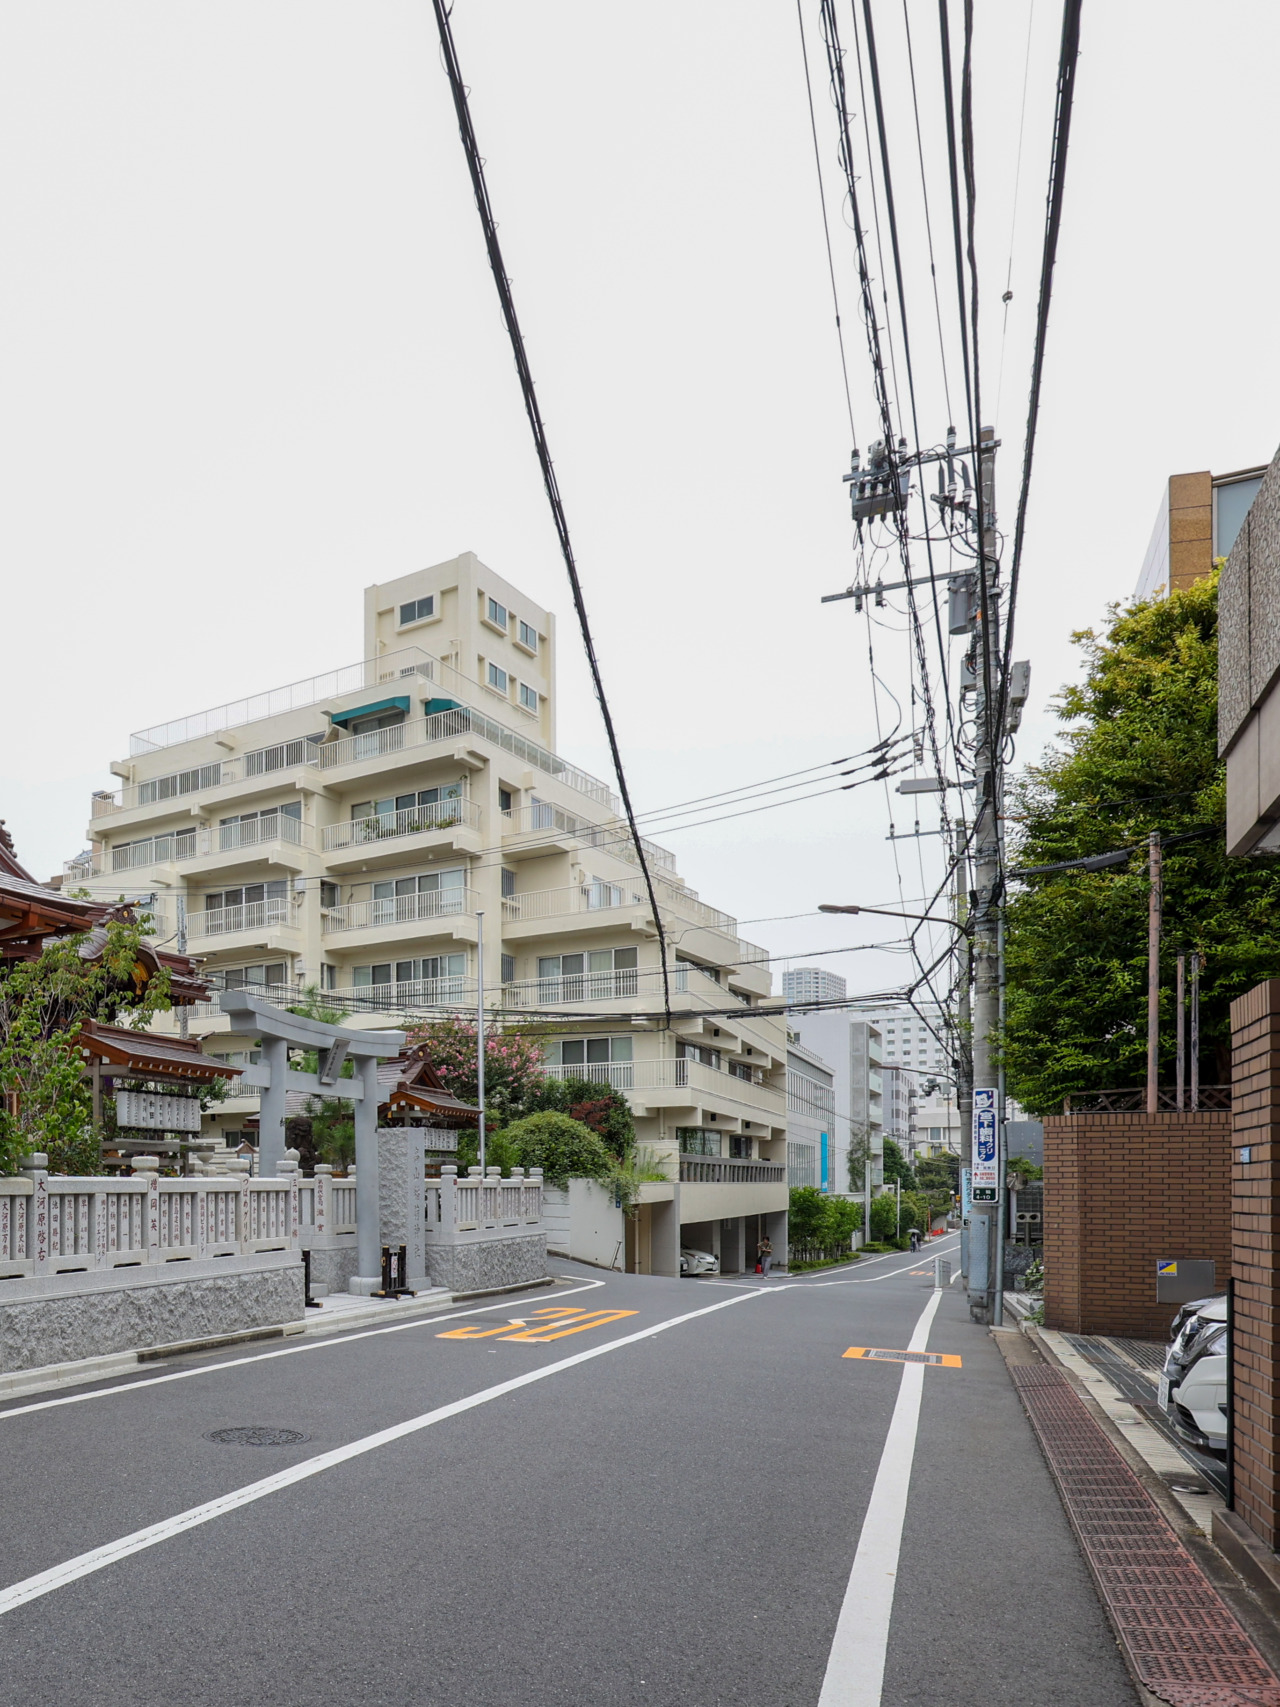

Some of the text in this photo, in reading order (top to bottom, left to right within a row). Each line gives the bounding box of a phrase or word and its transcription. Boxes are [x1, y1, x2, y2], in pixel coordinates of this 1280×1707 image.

[242, 1178, 250, 1243] つばめグリル
